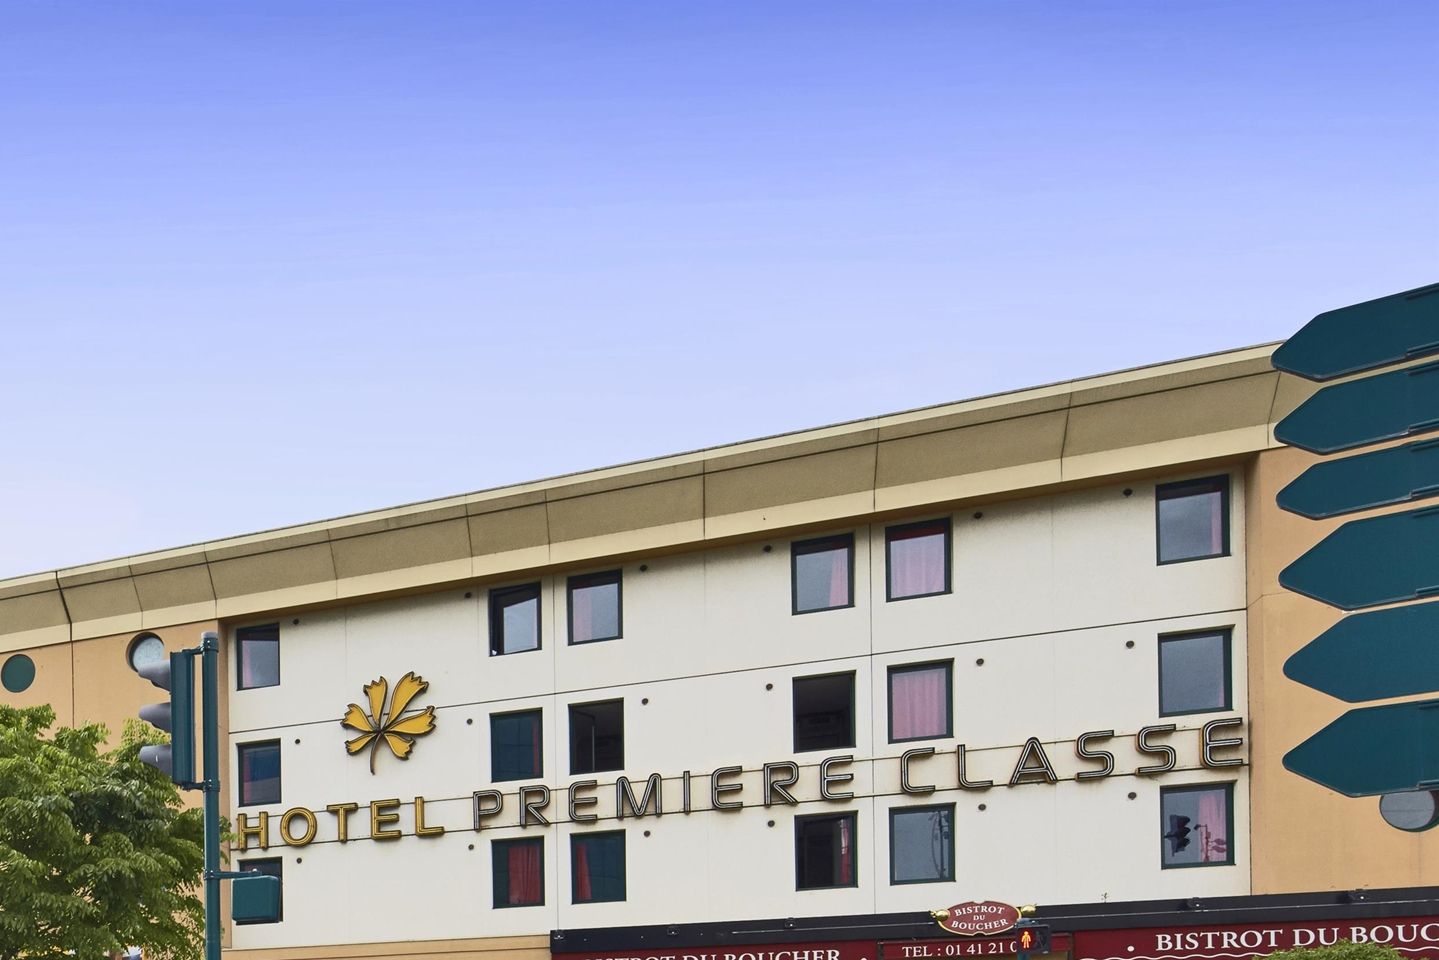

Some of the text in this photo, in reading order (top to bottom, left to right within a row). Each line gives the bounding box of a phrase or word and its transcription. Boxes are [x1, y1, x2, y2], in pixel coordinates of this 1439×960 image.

[238, 717, 1244, 852] HOTEL PREMIERE CLASSE
[954, 905, 1006, 917] BISTROT
[951, 918, 1009, 931] BOUCHER
[1155, 928, 1283, 951] BISTROT
[1292, 927, 1340, 947] DU
[902, 946, 933, 957] TEL
[945, 944, 960, 956] 01
[966, 943, 982, 954] 41
[988, 942, 1004, 954] 21
